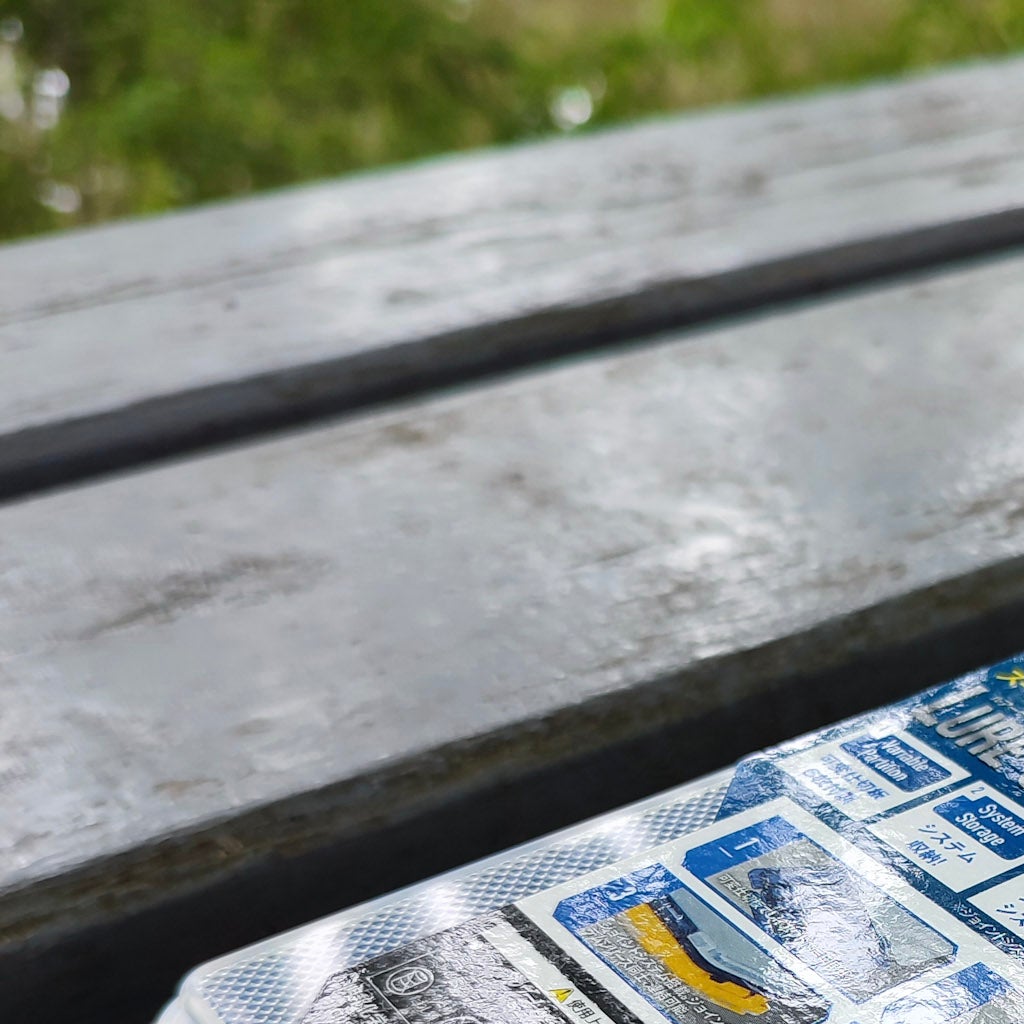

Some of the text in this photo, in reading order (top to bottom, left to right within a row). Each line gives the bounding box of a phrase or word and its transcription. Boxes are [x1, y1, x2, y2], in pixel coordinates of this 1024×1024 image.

[853, 747, 916, 782] Partition
[877, 739, 937, 772] Variable
[914, 822, 985, 864] システム
[947, 811, 1013, 849] Storage
